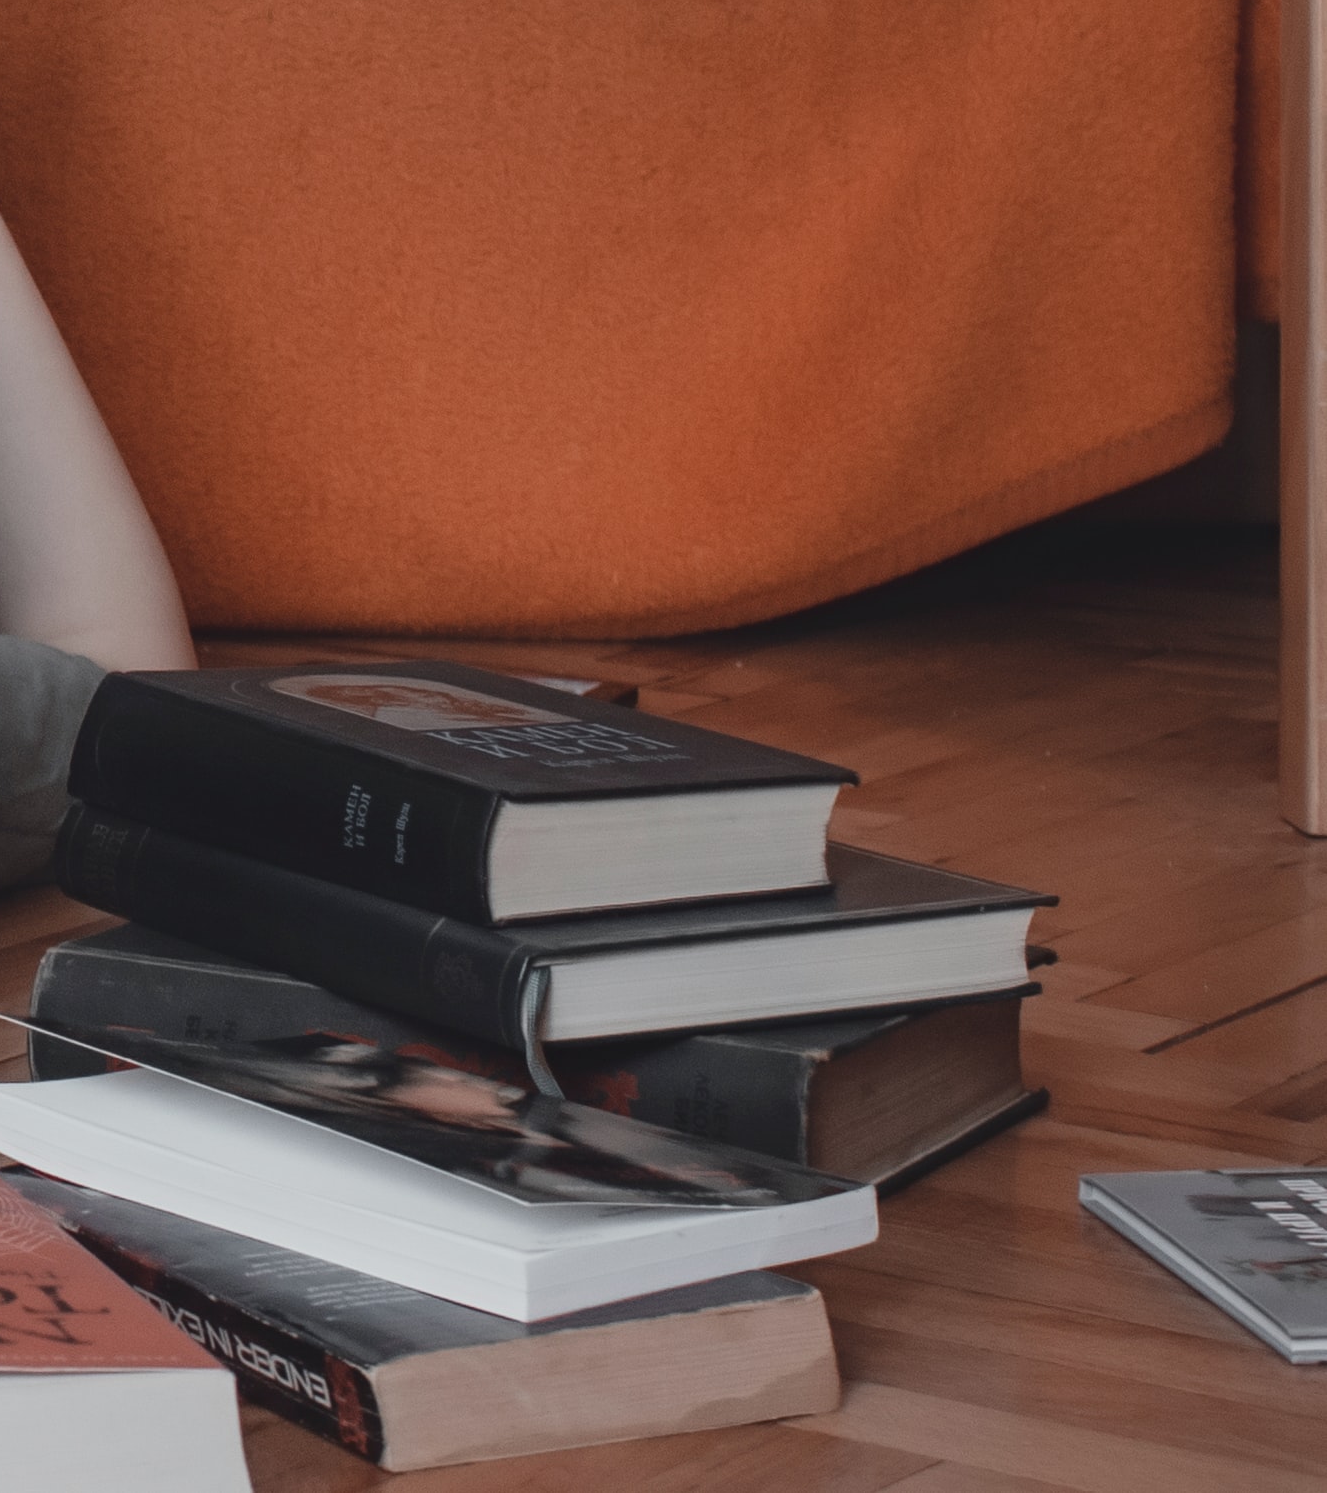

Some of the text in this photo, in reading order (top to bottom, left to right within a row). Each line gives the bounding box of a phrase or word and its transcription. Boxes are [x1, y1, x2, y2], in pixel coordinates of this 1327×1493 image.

[424, 724, 638, 745] КАМЕН
[466, 736, 677, 757] И БОЛ
[344, 784, 362, 848] КАМЕН
[205, 1320, 234, 1358] IN
[234, 1334, 332, 1408] ENDER
